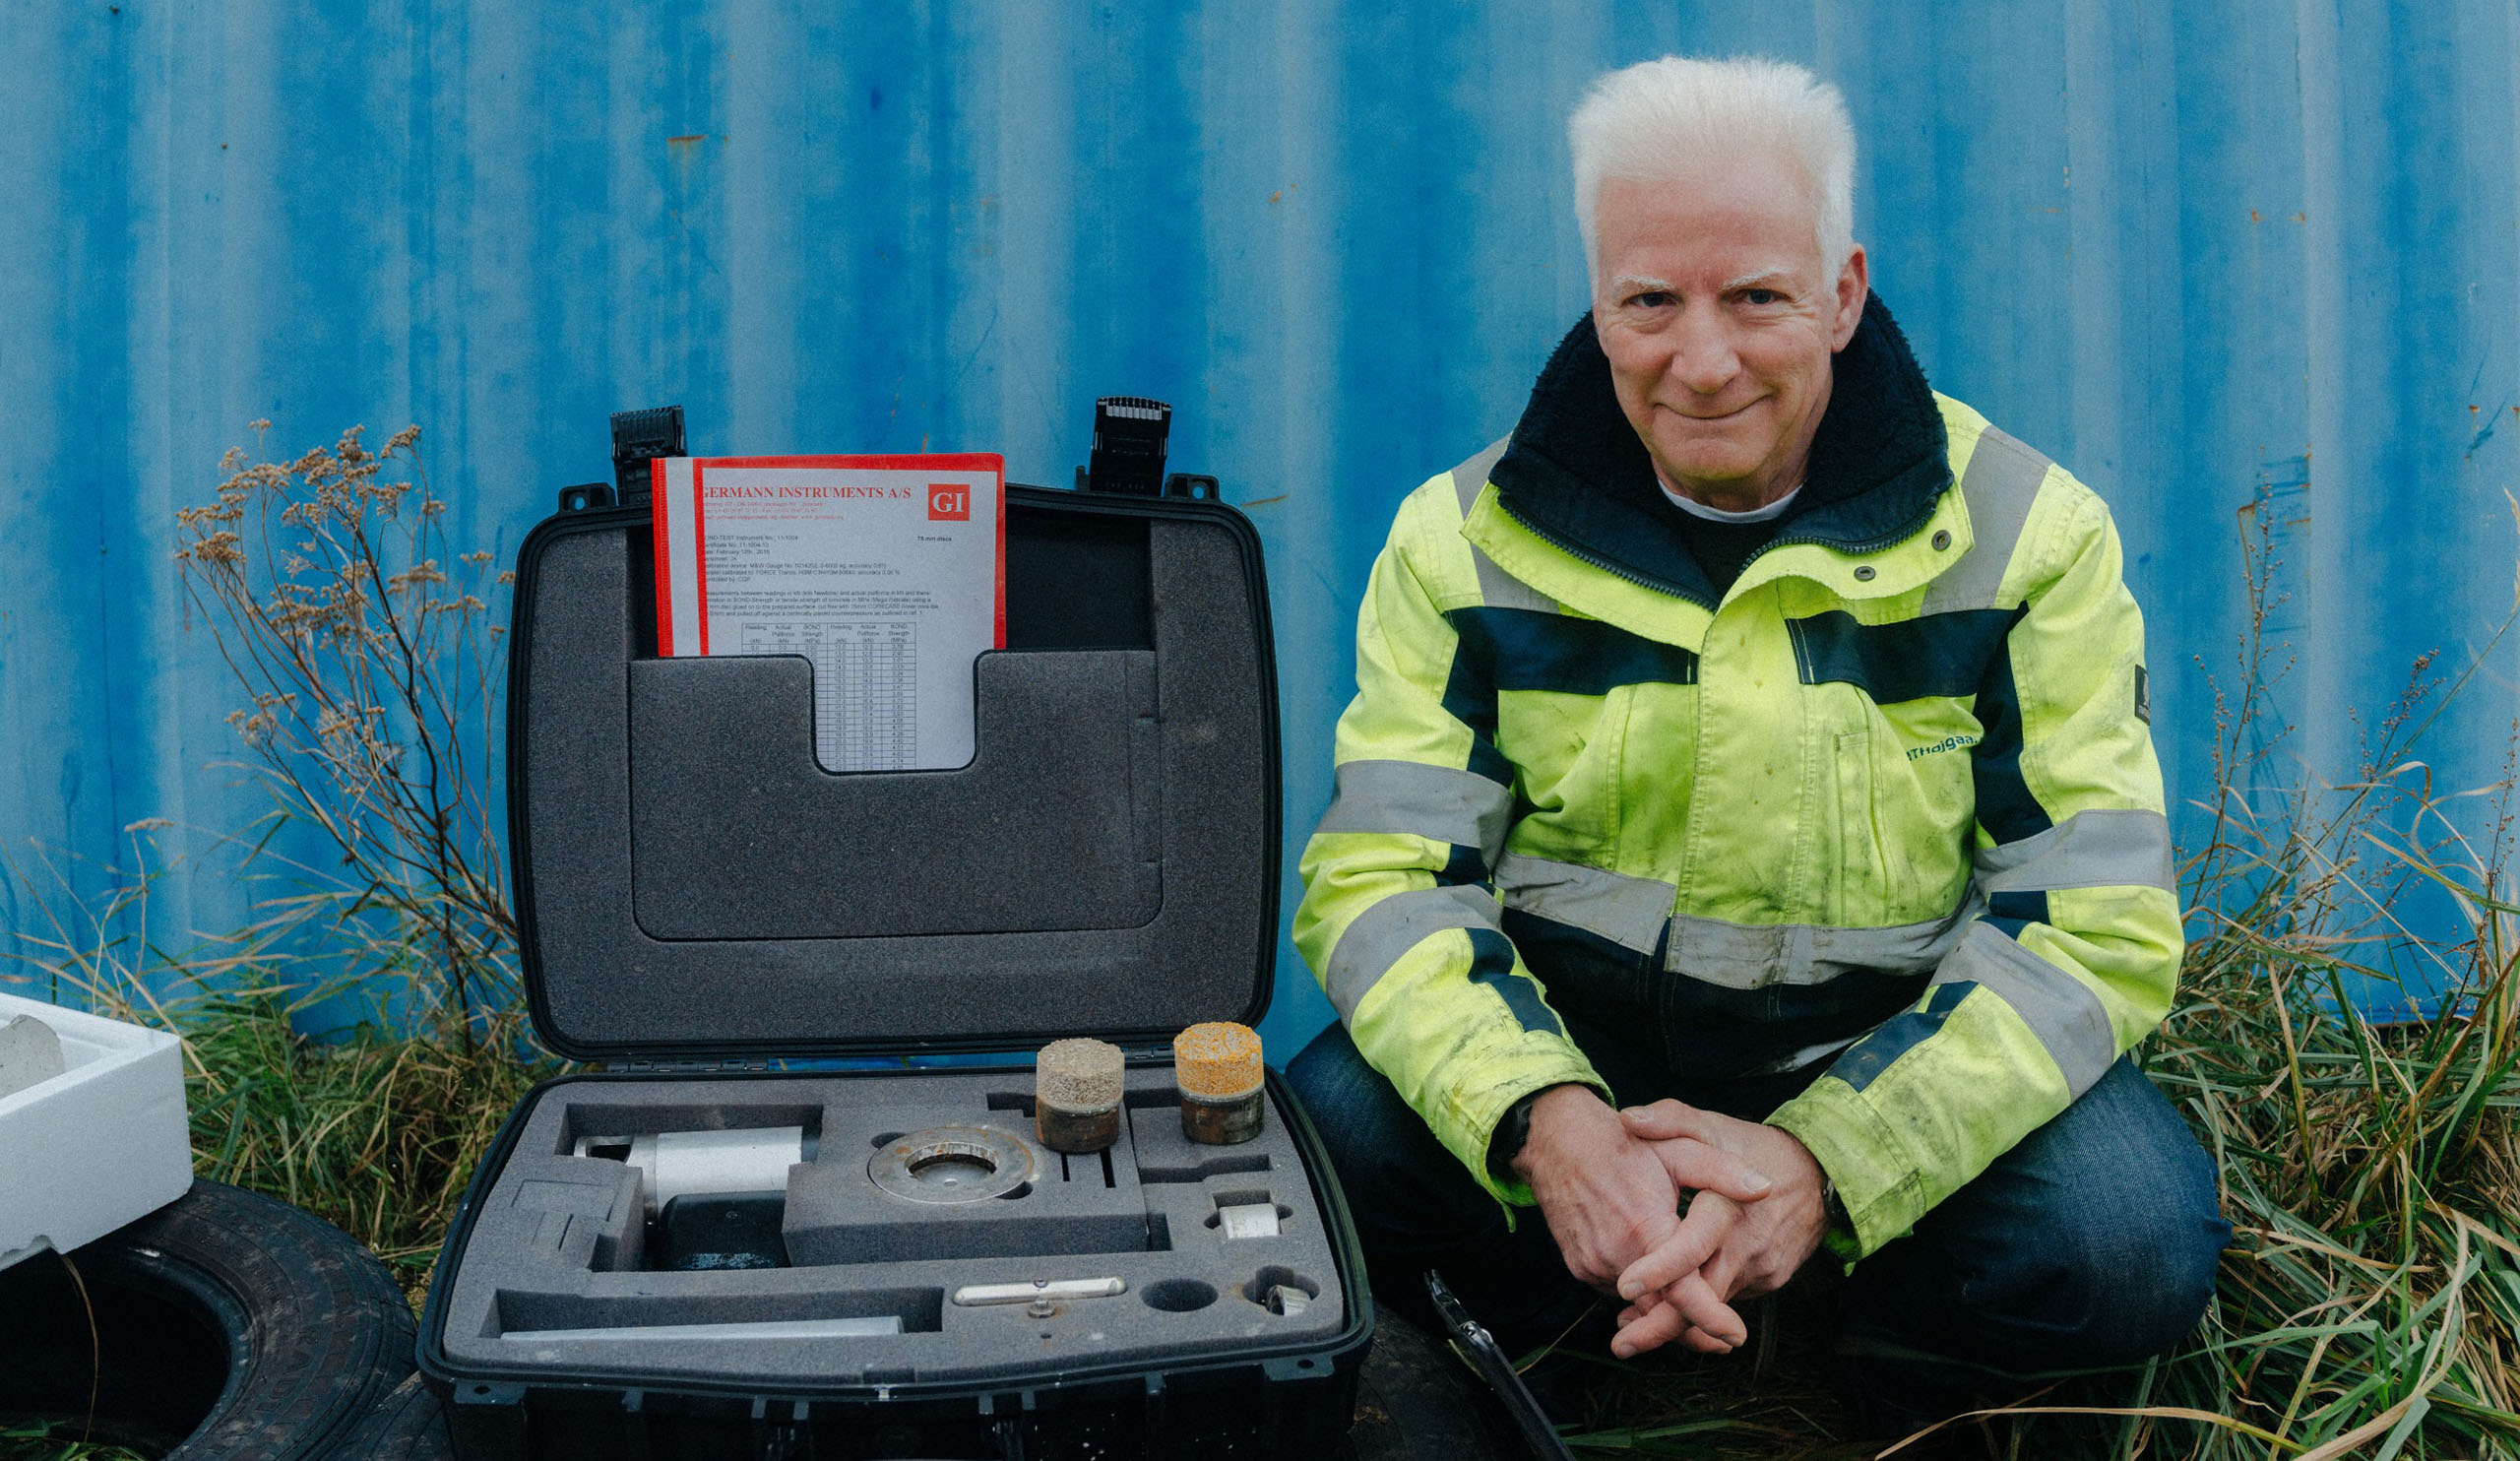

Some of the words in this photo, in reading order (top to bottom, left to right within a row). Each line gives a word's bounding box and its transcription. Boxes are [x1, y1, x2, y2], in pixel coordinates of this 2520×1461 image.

[779, 486, 884, 498] INSTRUMENTS
[888, 486, 912, 498] A/S
[932, 492, 965, 513] GI
